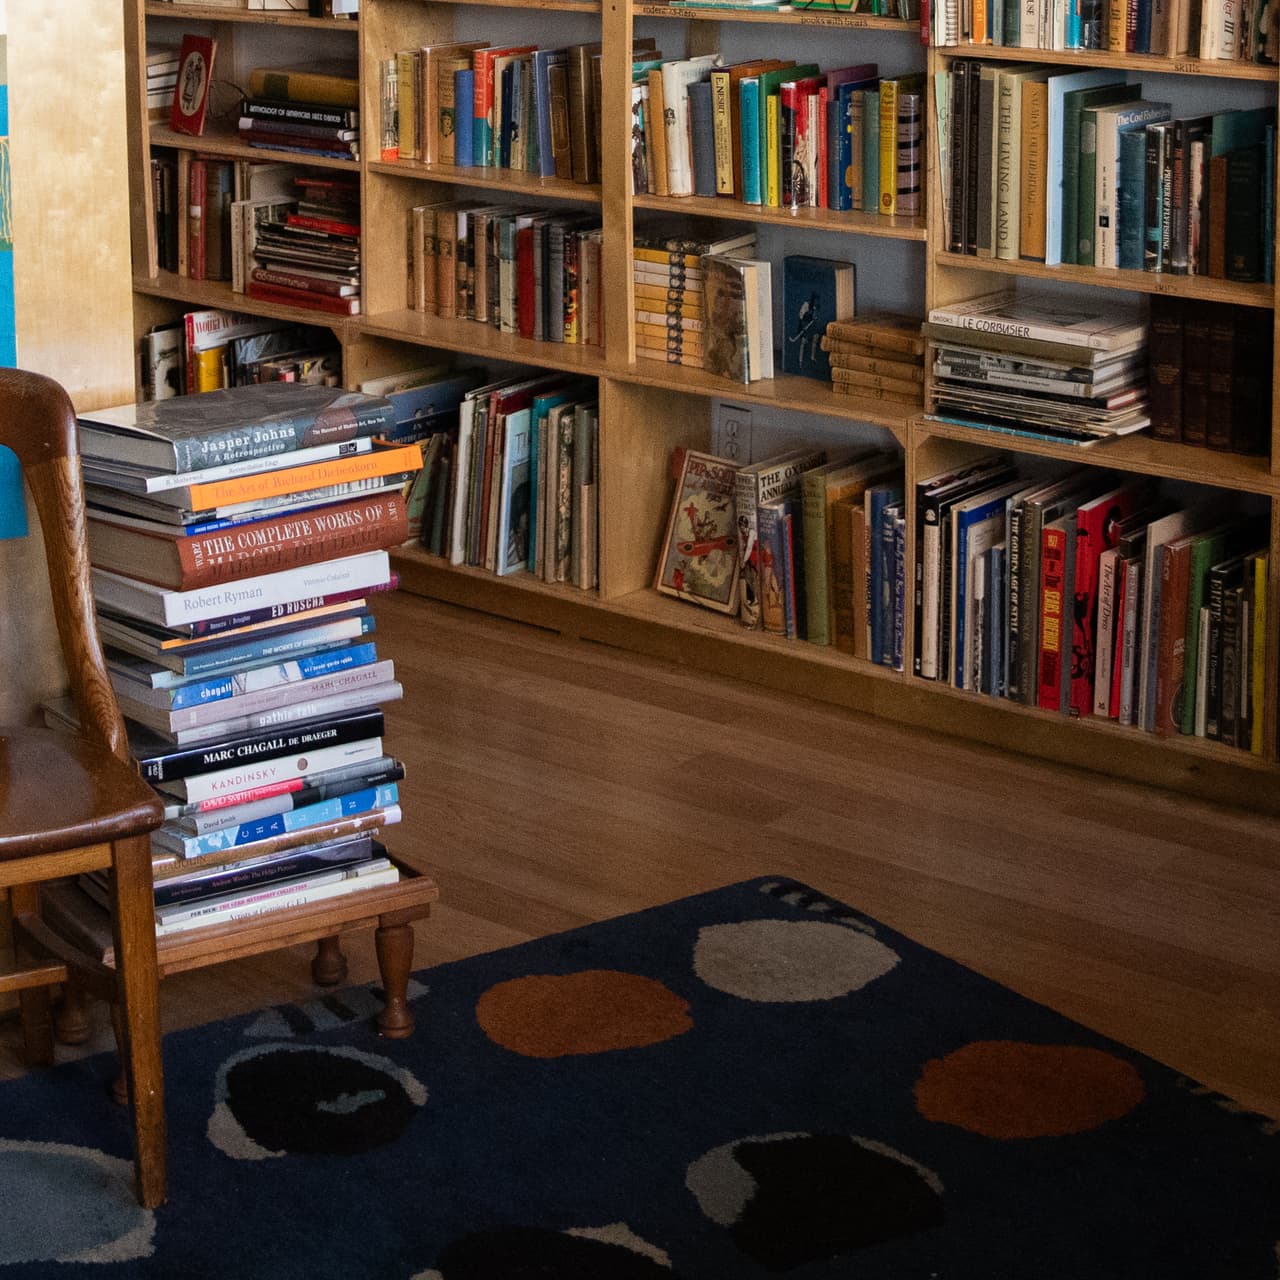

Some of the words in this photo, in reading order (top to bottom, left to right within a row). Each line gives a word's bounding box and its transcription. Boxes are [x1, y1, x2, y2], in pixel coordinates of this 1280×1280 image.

[800, 15, 821, 26] books
[823, 16, 841, 26] with
[842, 18, 869, 28] bears
[1174, 63, 1201, 72] skills
[1000, 103, 1011, 136] THE
[999, 141, 1011, 193] LIVING
[999, 202, 1010, 241] LAND
[962, 317, 974, 329] LE
[975, 319, 1031, 337] CORBUSIER
[201, 434, 251, 455] Jasper
[253, 425, 296, 444] Johns
[214, 453, 221, 462] A
[223, 442, 286, 462] Retrospective
[213, 486, 233, 499] The
[236, 482, 255, 496] Art
[258, 480, 268, 491] of
[273, 469, 316, 489] Richard
[318, 461, 378, 480] Diebenkorn
[203, 534, 233, 556] THE
[237, 521, 312, 549] COMPLETE
[314, 509, 362, 535] WORKS
[365, 504, 384, 522] OF
[1104, 564, 1114, 579] The
[183, 593, 221, 611] Robert
[223, 586, 263, 607] Ryman
[1103, 581, 1112, 595] Art
[271, 604, 284, 618] ED
[286, 596, 325, 615] RUSCHA
[1100, 607, 1111, 632] Dress
[200, 683, 232, 699] chagall
[312, 680, 335, 692] MARC
[339, 671, 377, 687] CHAGALL
[204, 748, 234, 764] MARC
[237, 738, 286, 757] CHAGALL
[288, 736, 300, 745] DE
[301, 729, 338, 743] DRAEGER
[211, 767, 277, 792] KANDINSKY
[204, 818, 219, 829] David
[221, 815, 236, 826] Smith
